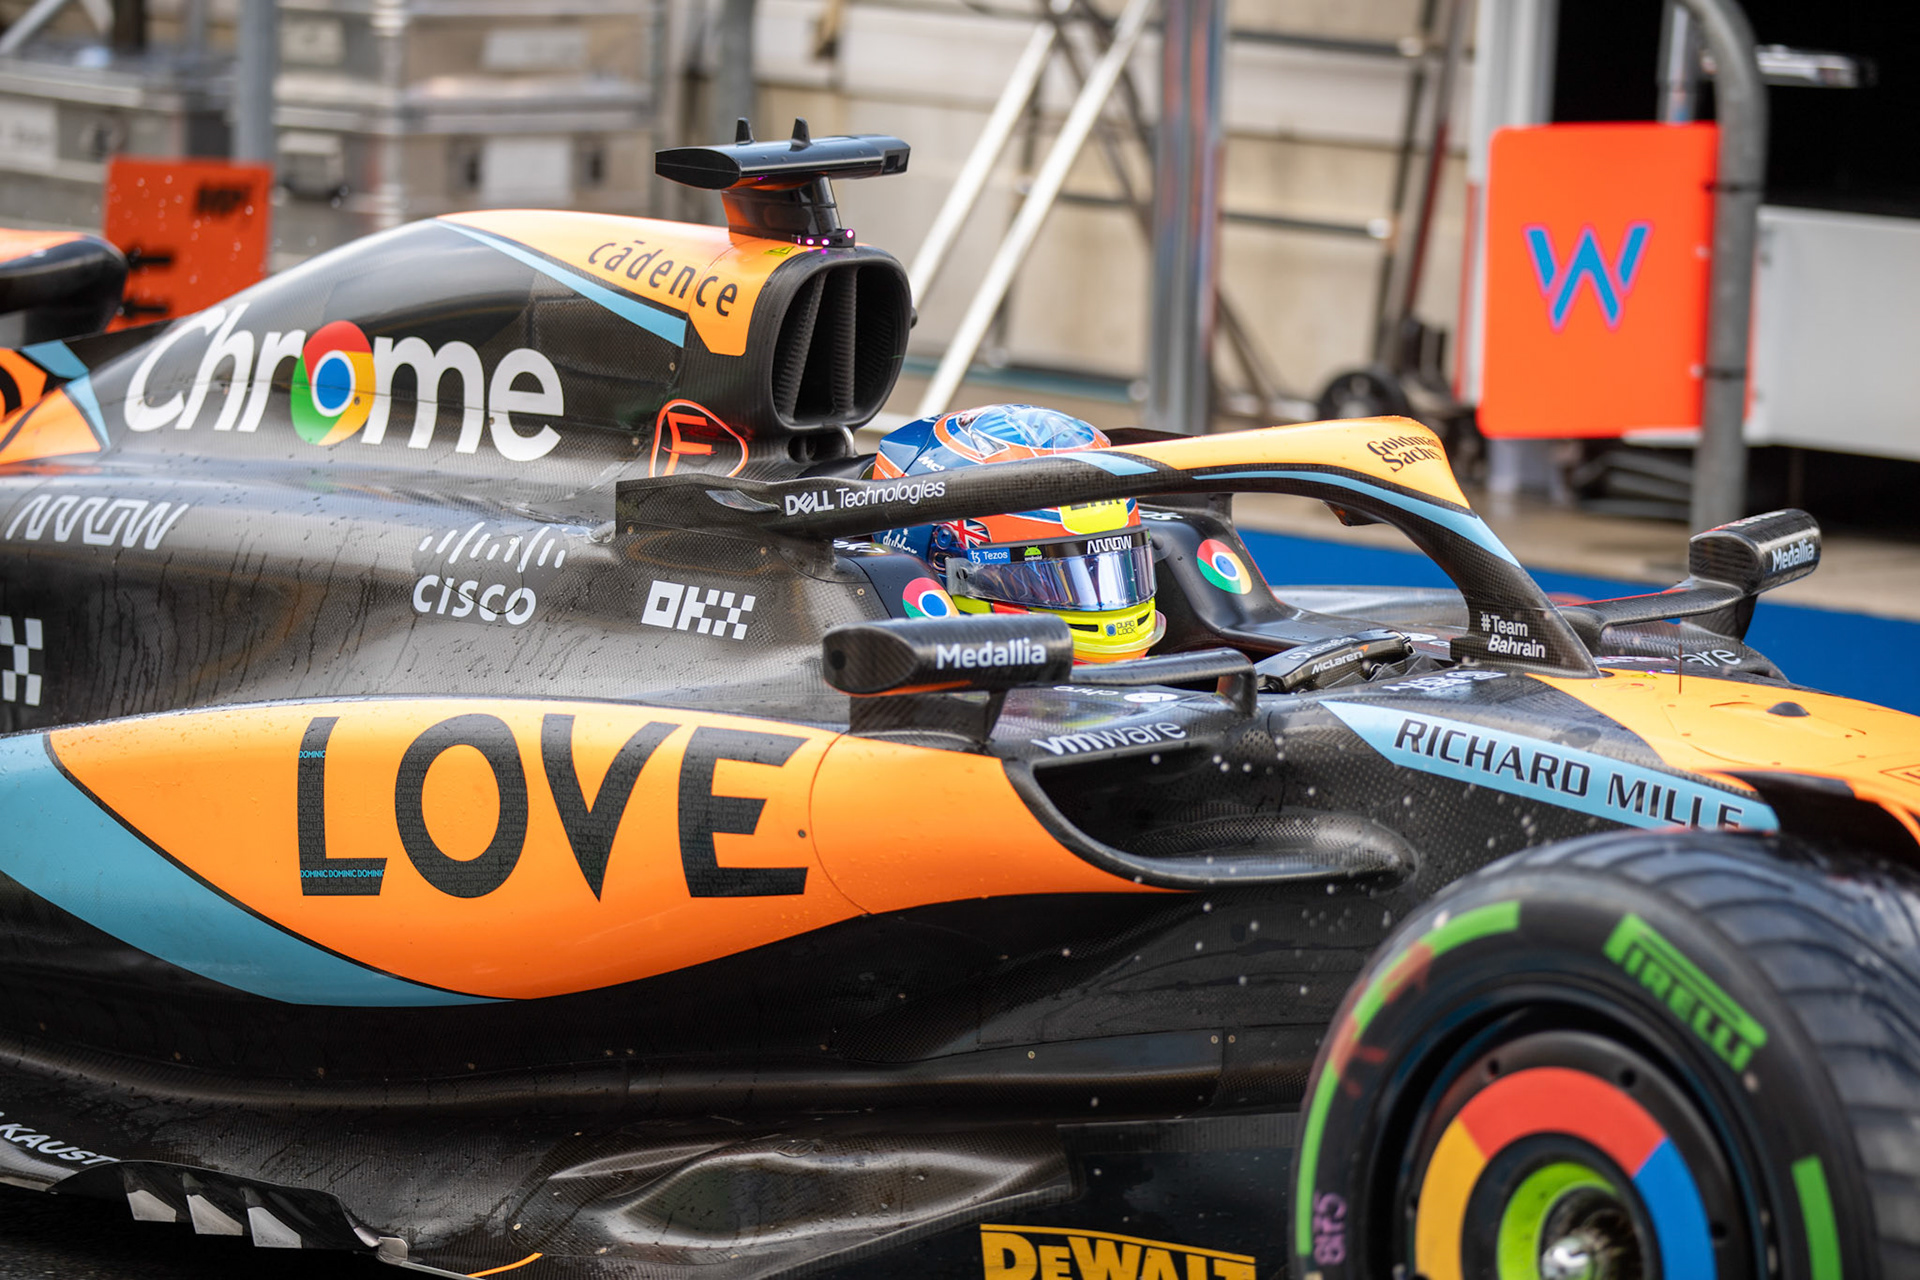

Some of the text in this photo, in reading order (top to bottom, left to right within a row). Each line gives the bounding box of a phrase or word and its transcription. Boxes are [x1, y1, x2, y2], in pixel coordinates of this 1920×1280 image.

[124, 300, 564, 461] Chrome
[1382, 446, 1442, 472] Sachs
[785, 480, 946, 516] DELL Technologies
[982, 550, 1009, 561] Tezos
[1772, 539, 1815, 572] Medallia
[641, 580, 756, 640] OKX
[1481, 612, 1528, 638] #Team
[936, 637, 1047, 670] Medallia
[1311, 651, 1364, 675] McLaren
[1488, 636, 1546, 659] Bahrain
[1031, 722, 1187, 755] vmware
[1393, 717, 1744, 830] RICHARD MILLE
[297, 713, 810, 901] LOVE
[329, 869, 357, 878] DOMINIC
[1602, 913, 1768, 1072] PIRELLI
[0, 1123, 120, 1165] KAUST
